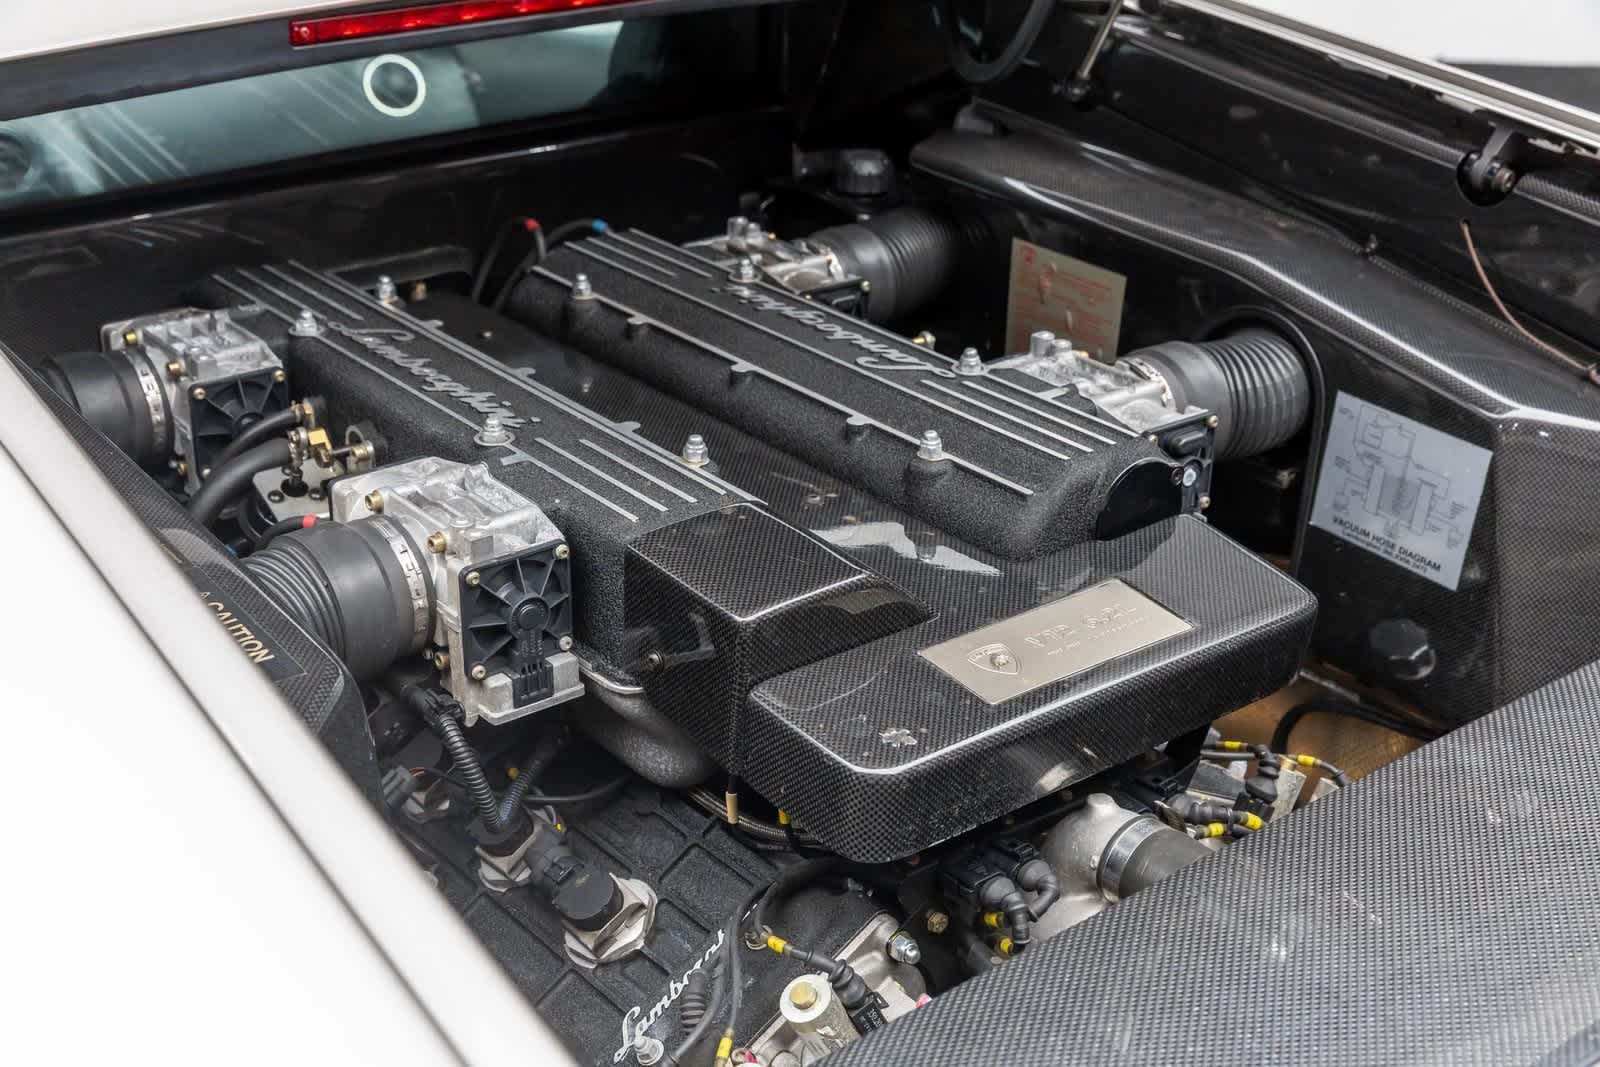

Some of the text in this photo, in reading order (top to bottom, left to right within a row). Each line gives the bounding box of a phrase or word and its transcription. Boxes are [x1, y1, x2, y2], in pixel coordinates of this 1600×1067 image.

[712, 285, 957, 379] Lamborghini
[327, 320, 542, 428] Lamborghini
[1333, 516, 1371, 538] VACUUM
[1372, 534, 1395, 551] HOSE
[1398, 546, 1442, 573] DIAGRAM
[207, 600, 276, 664] CAUTION
